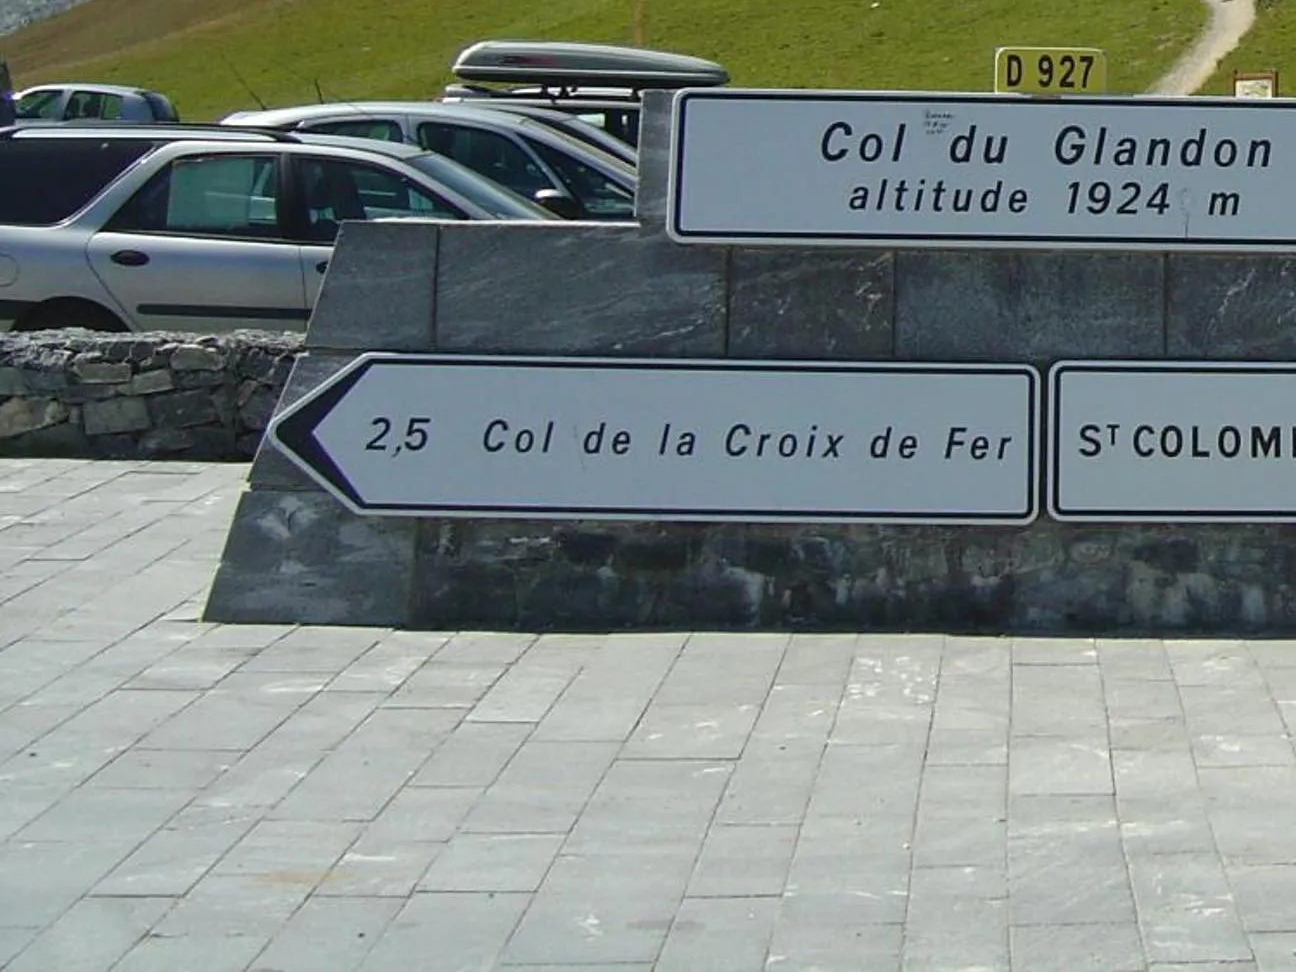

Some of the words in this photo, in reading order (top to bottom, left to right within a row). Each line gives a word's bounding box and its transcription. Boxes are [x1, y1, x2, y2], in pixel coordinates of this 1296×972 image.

[1006, 54, 1023, 88] D
[1037, 54, 1095, 89] 927
[821, 121, 907, 163] Col
[949, 124, 1009, 165] du
[1054, 124, 1273, 168] Glandon
[848, 178, 1028, 214] altitude
[1067, 181, 1172, 216] 1924
[1207, 191, 1241, 217] m
[364, 416, 432, 459] 2,5
[483, 418, 555, 454] Col
[583, 421, 632, 456] de
[658, 423, 697, 457] la
[725, 423, 846, 459] Croix
[869, 426, 919, 460] de
[944, 426, 1013, 461] Fer
